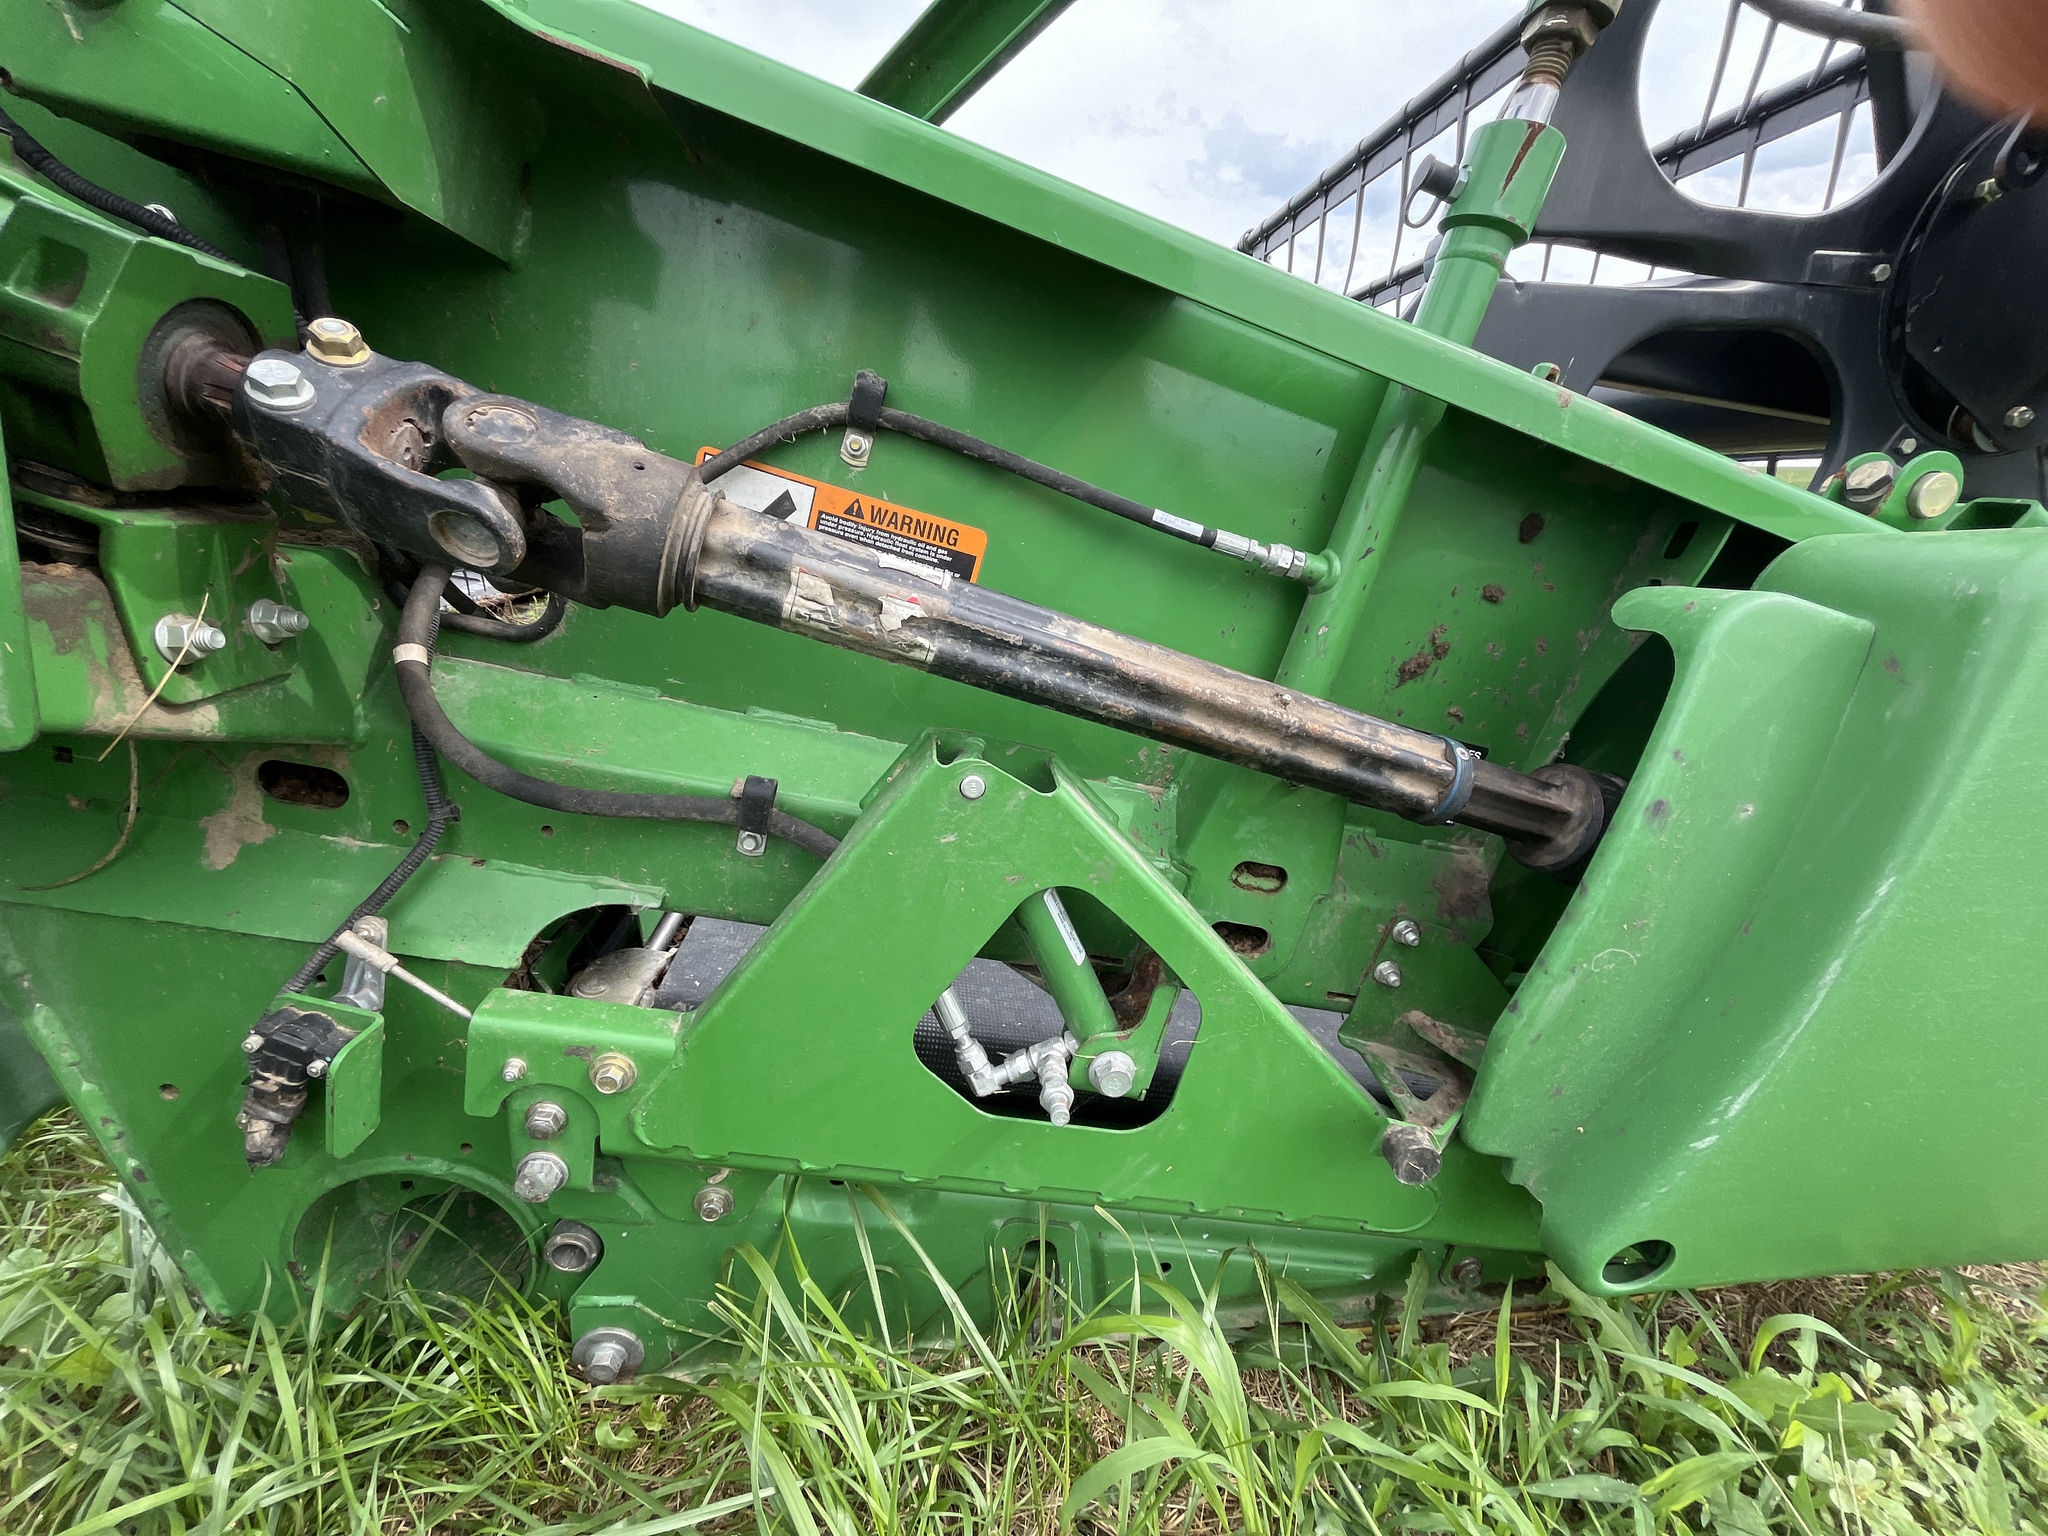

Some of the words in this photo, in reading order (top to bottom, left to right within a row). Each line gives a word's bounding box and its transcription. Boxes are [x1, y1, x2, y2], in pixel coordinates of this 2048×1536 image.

[819, 525, 843, 535] pressure
[875, 541, 900, 552] detached
[901, 548, 914, 556] from
[915, 553, 939, 563] combine.
[820, 519, 837, 527] under
[838, 524, 865, 536] pressure.
[866, 533, 894, 545] Hydraulic
[895, 539, 908, 548] float
[909, 545, 929, 555] system
[936, 553, 952, 561] under
[821, 513, 838, 522] Avoid
[839, 518, 857, 529] bodily
[859, 524, 875, 534] injury
[876, 530, 889, 538] from
[891, 534, 917, 546] hydraulic
[870, 505, 960, 547] WARNING
